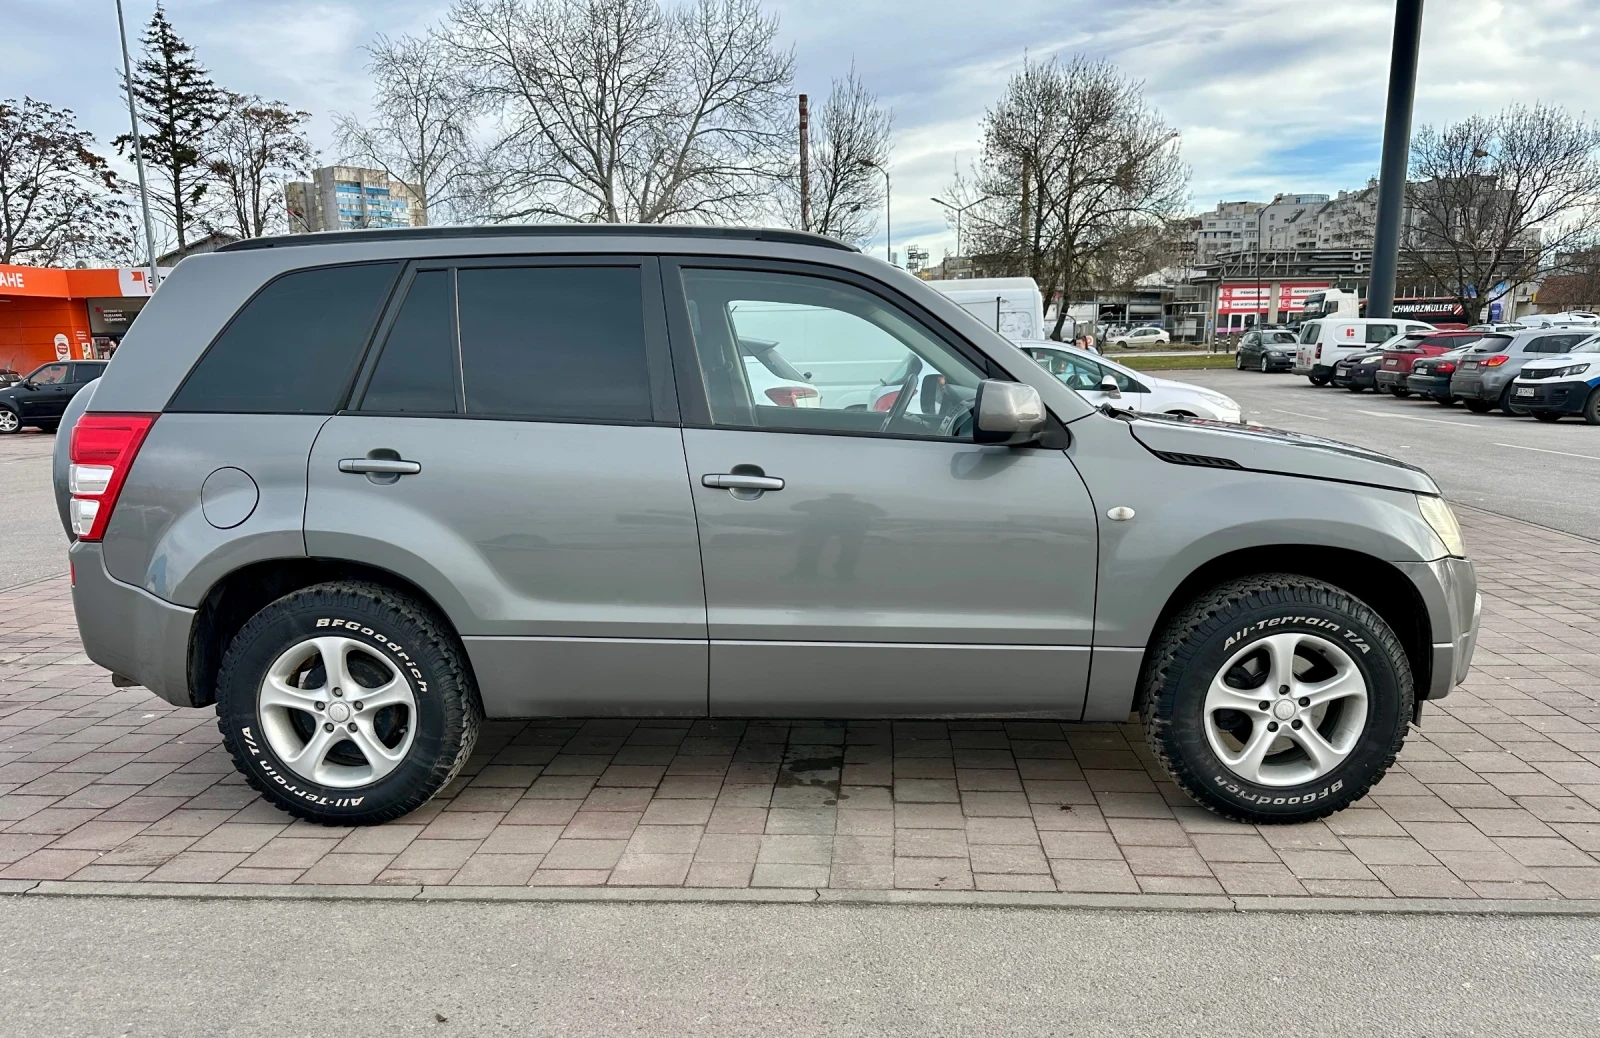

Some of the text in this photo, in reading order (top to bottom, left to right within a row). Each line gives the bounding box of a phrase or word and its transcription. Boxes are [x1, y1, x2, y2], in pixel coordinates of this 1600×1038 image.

[1223, 615, 1371, 655] All-Terrain T/A
[316, 618, 428, 693] BFGoodrich
[1213, 775, 1344, 806] BFGoodrich
